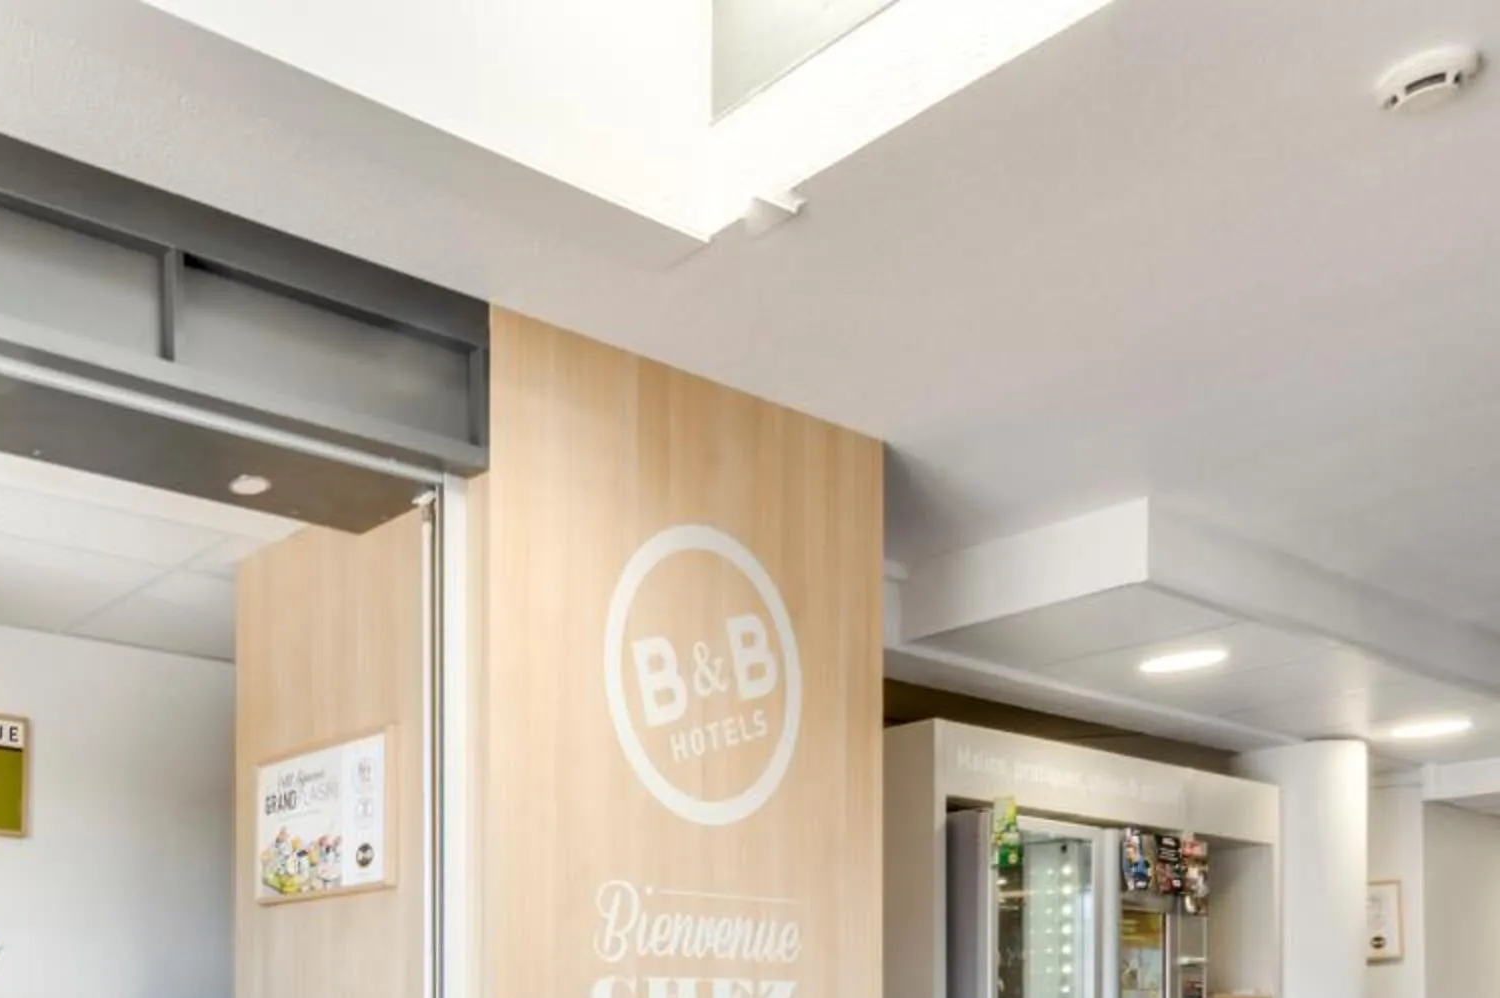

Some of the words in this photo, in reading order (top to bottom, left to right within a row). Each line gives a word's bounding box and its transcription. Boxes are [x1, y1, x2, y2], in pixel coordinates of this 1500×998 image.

[631, 612, 778, 728] B&B
[669, 709, 769, 762] HOTELS
[593, 880, 801, 963] Bienvenue
